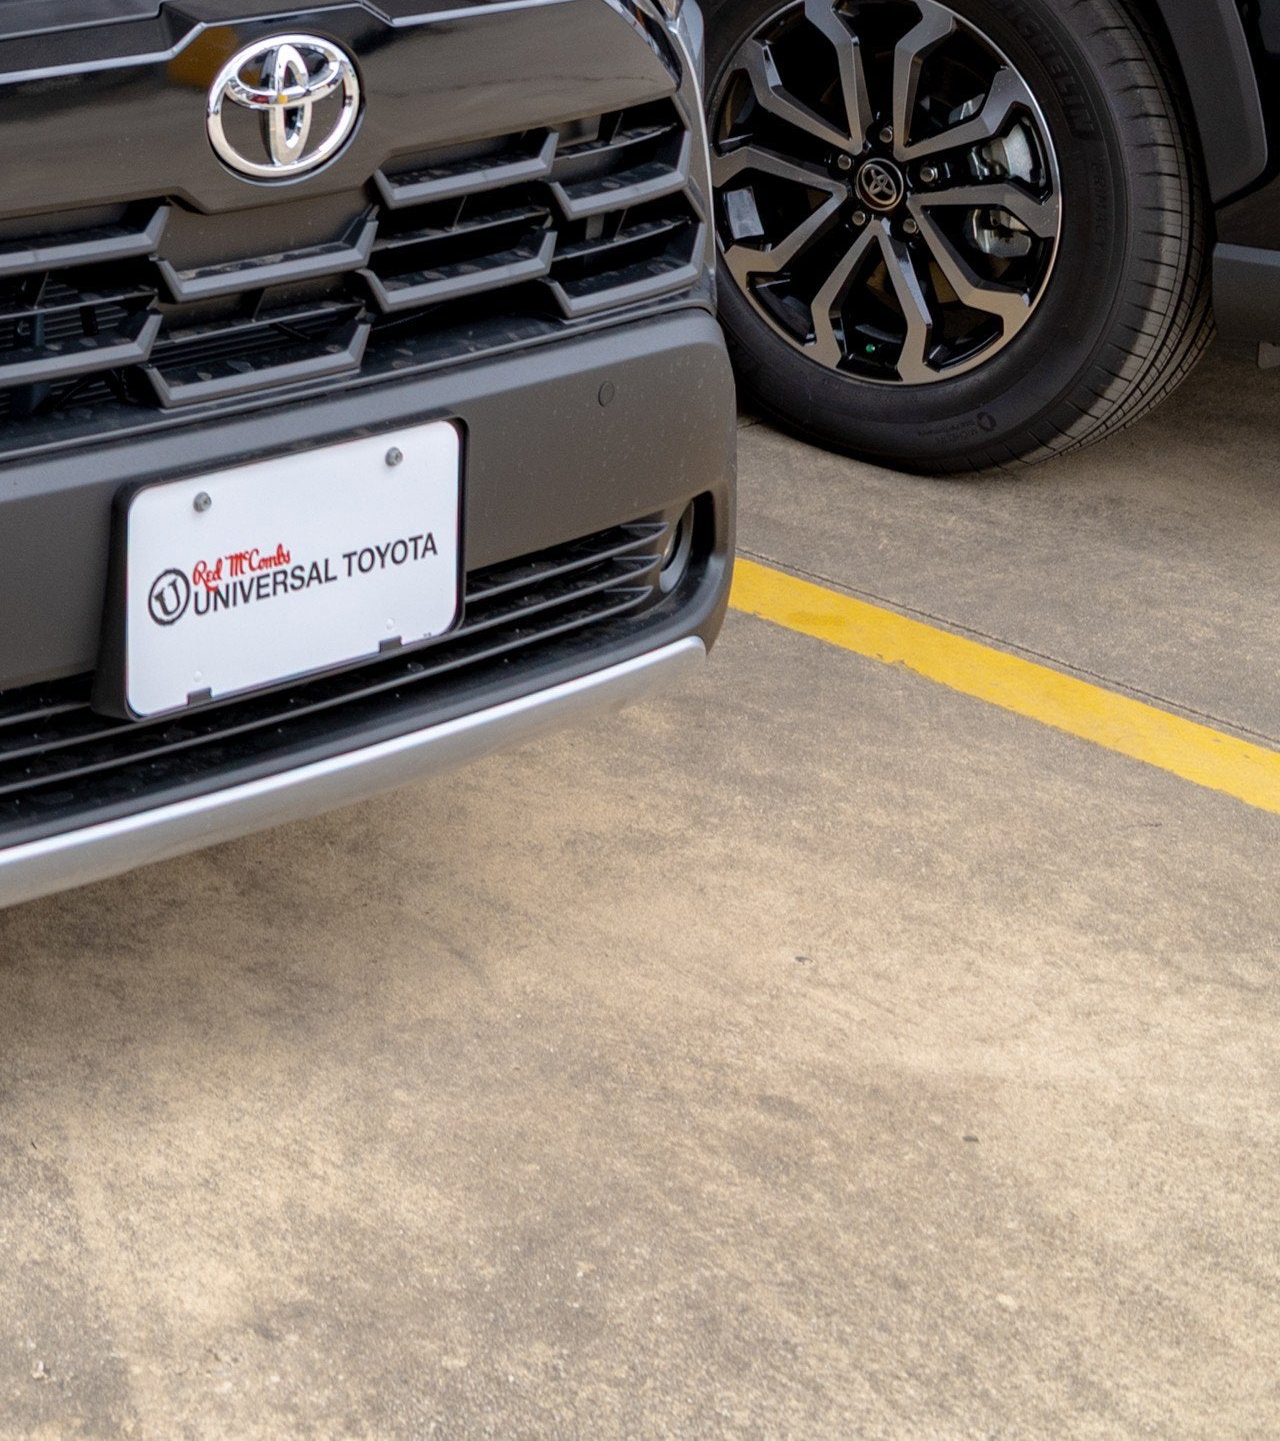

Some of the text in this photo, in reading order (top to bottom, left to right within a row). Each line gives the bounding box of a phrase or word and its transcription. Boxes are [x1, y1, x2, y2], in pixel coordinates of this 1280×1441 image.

[193, 543, 291, 592] Red McCombs
[194, 532, 439, 616] UNIVERSAL TOYOTA
